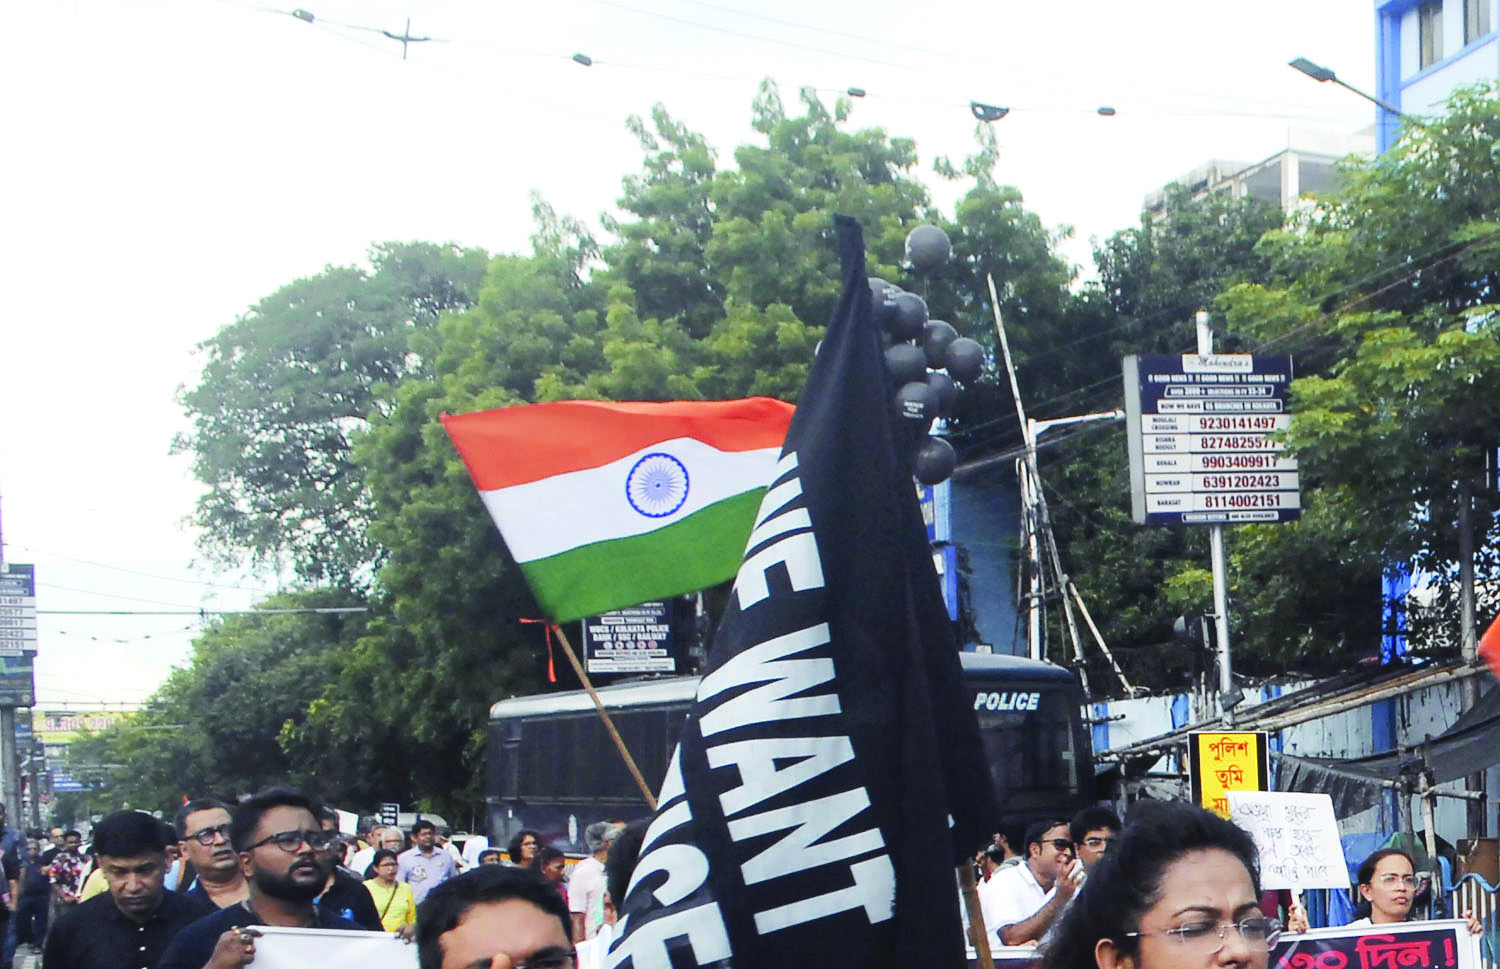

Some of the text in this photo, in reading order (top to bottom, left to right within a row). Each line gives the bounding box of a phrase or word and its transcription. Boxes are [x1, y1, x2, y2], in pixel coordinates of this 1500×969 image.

[1200, 417, 1276, 430] 9230141497
[1202, 456, 1277, 469] 9903409917
[1203, 475, 1280, 488] 6391202423
[1205, 494, 1281, 508] 8114002151
[694, 451, 897, 936] WE WANT
[974, 692, 1040, 711] POLICE
[1209, 736, 1248, 762] পুলিশ
[1215, 765, 1243, 790] তুমি
